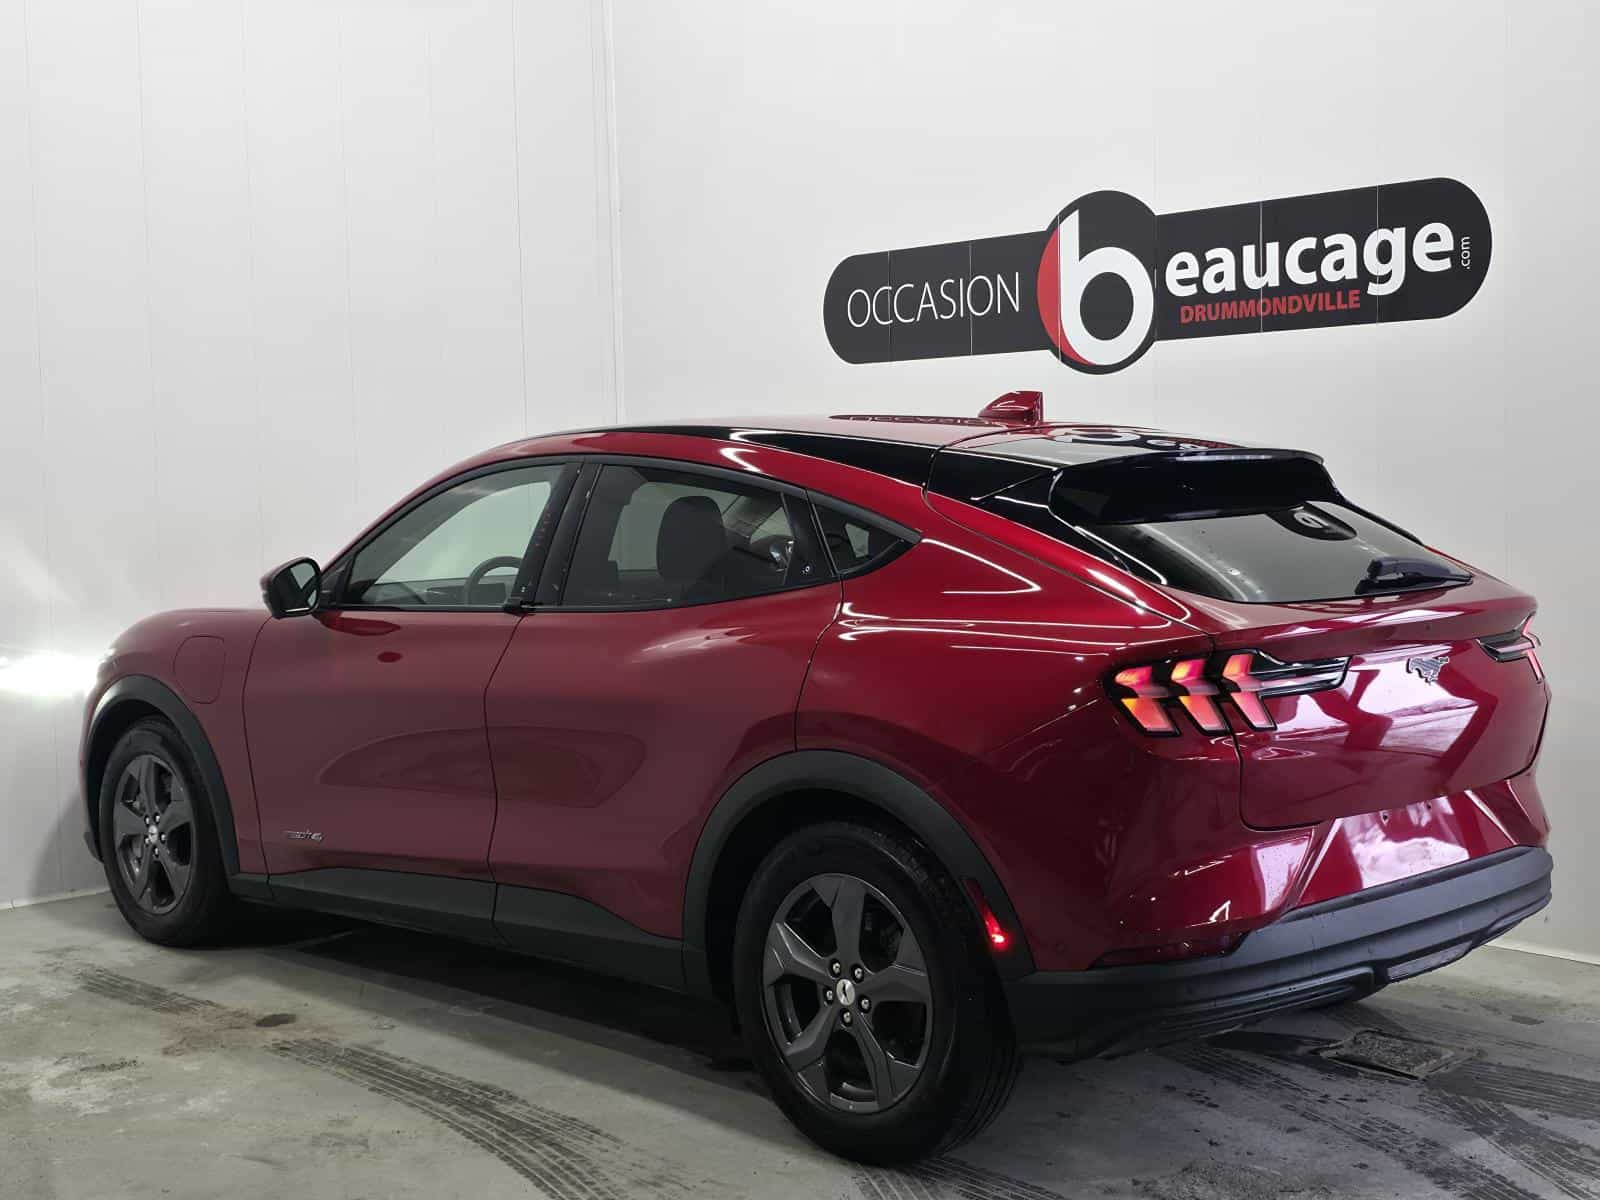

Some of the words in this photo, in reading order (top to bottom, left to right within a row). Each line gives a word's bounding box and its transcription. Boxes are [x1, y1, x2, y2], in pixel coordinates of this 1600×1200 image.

[847, 271, 1020, 328] OCCASION
[1461, 236, 1471, 270] .com
[1180, 289, 1361, 324] DRUMMONDVILLE
